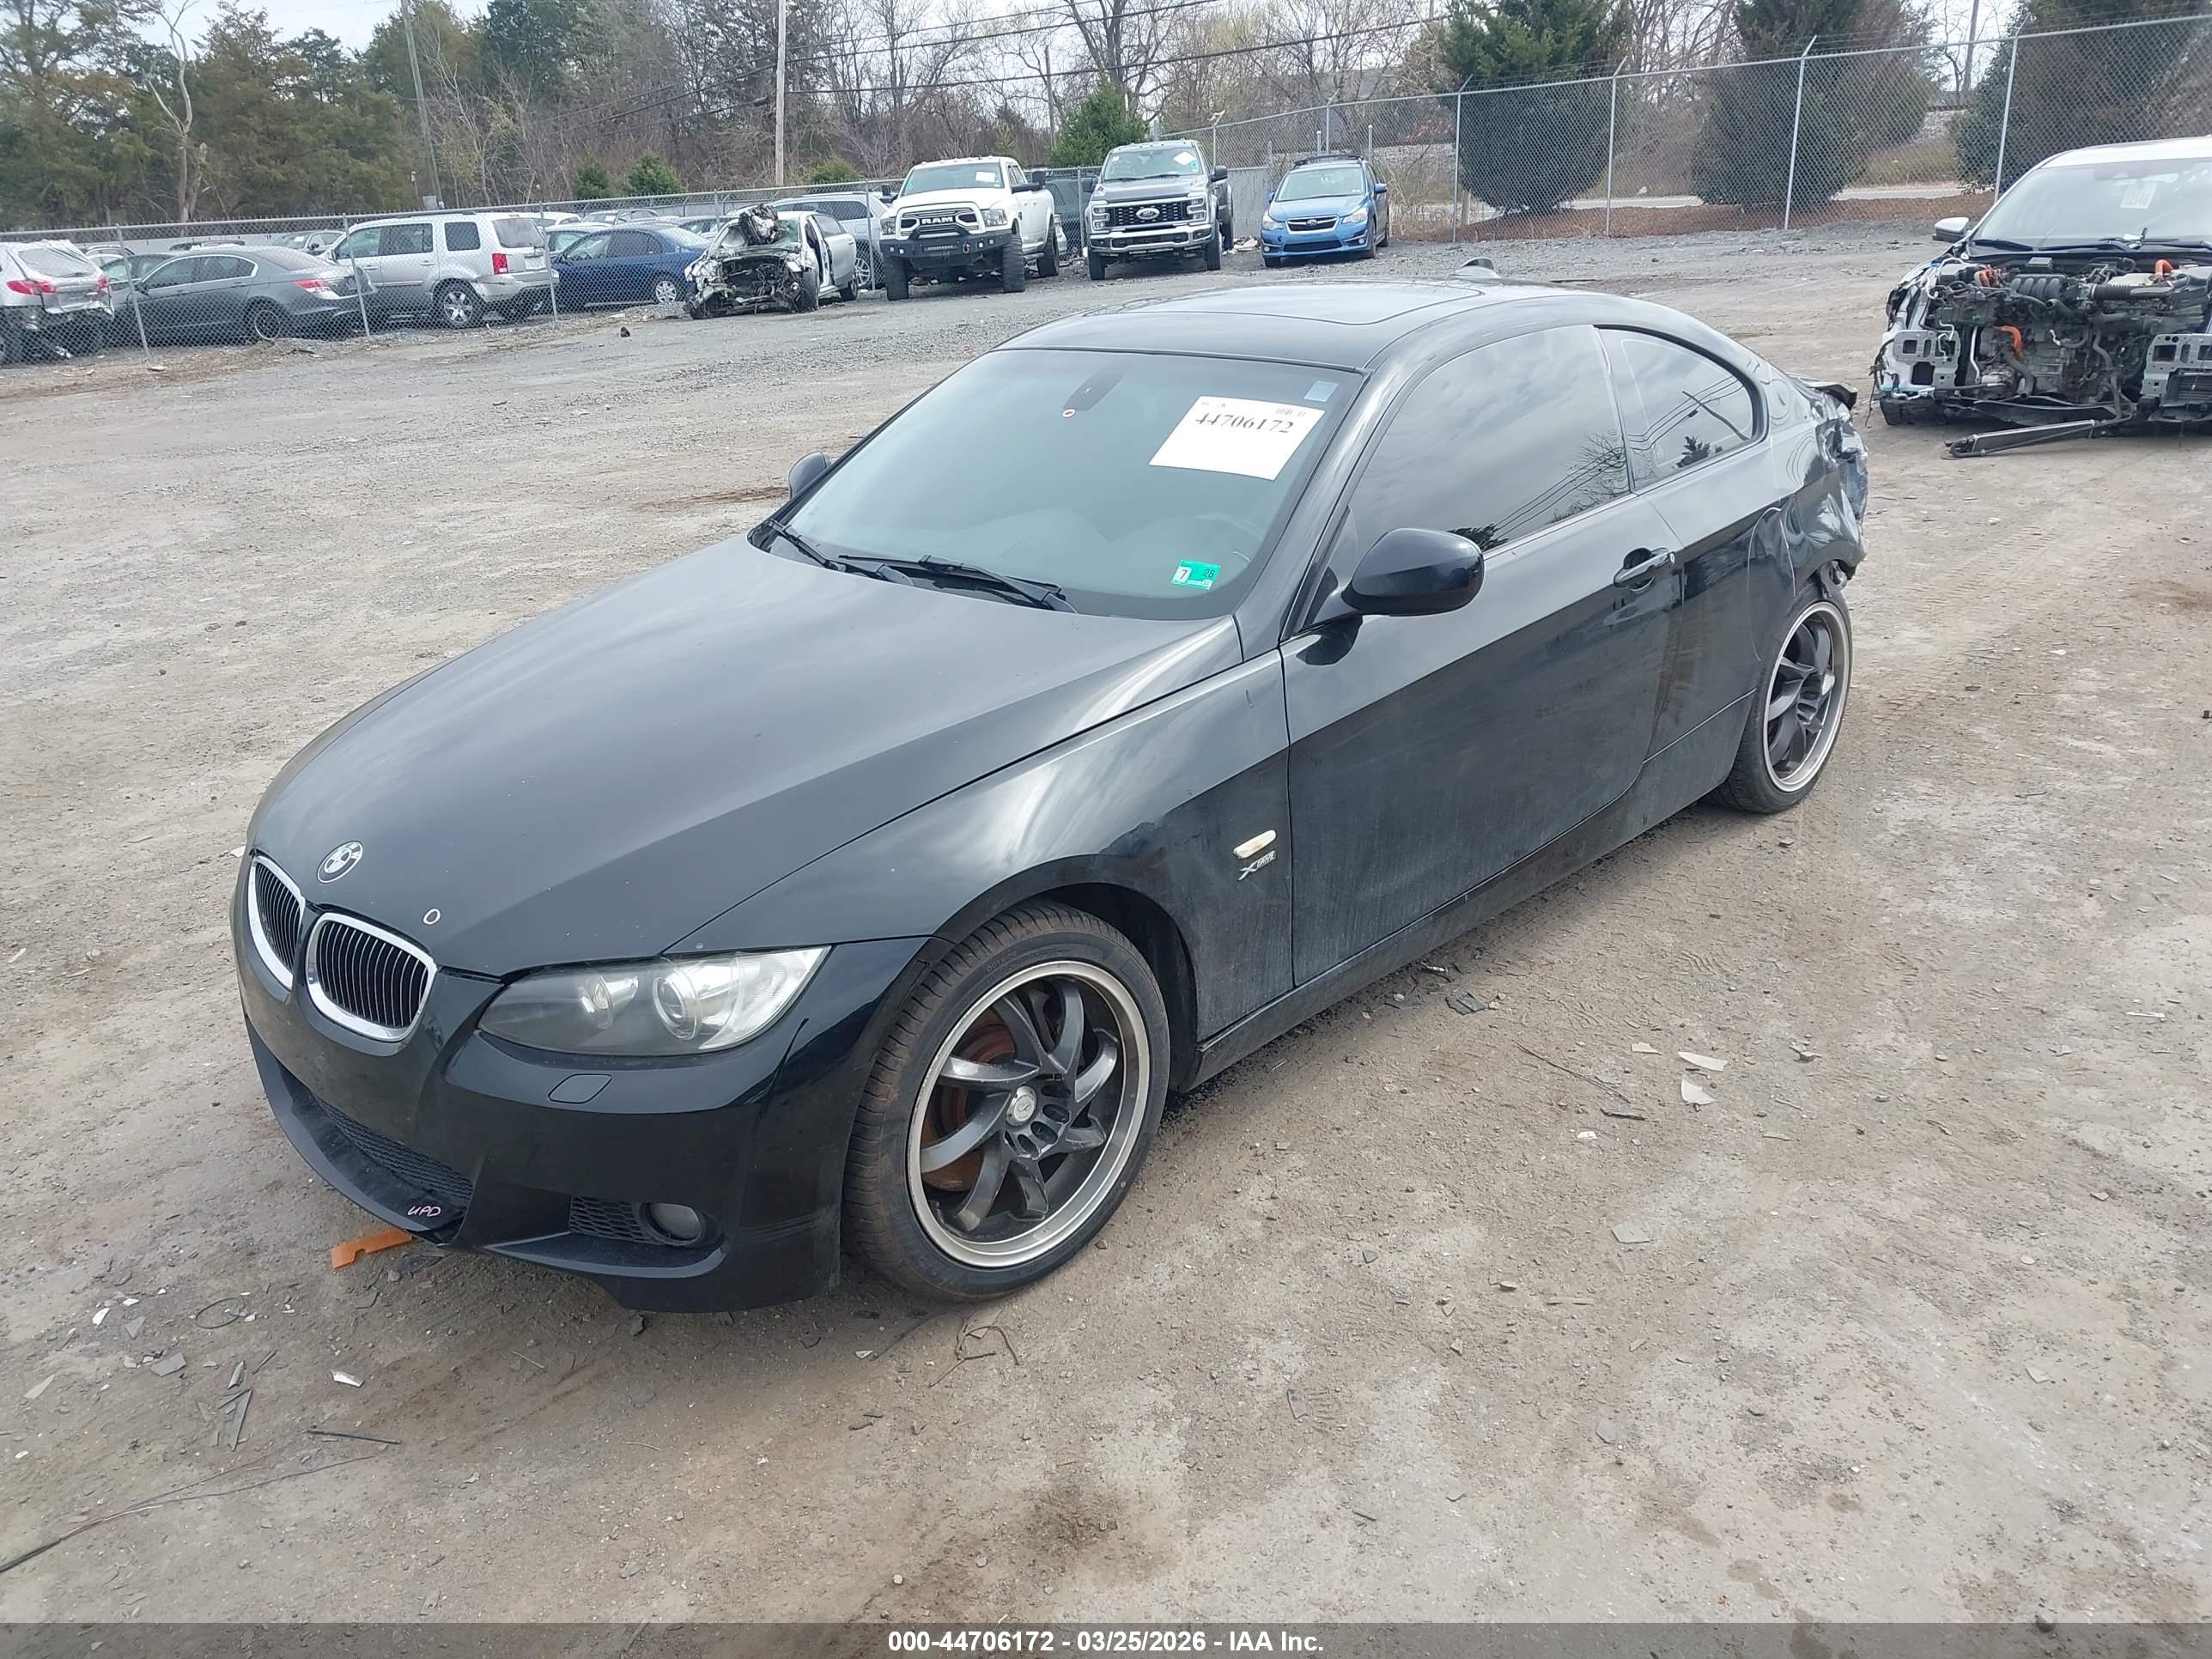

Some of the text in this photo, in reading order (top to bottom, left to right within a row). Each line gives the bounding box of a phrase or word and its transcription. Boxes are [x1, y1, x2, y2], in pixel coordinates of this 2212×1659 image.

[921, 216, 955, 225] RAM
[1195, 412, 1294, 434] 44706172
[1179, 569, 1188, 580] 7
